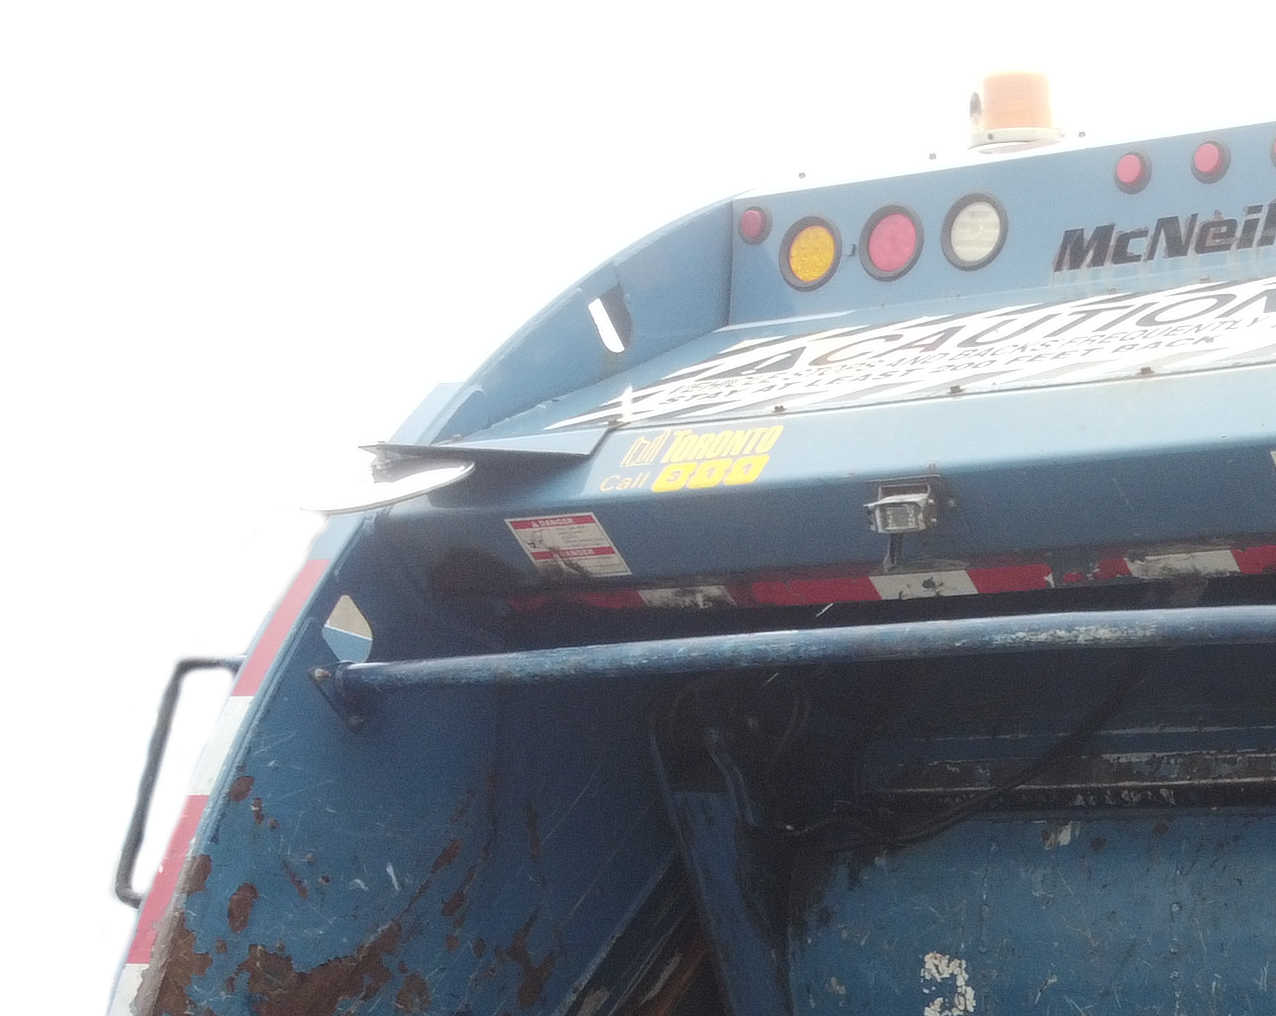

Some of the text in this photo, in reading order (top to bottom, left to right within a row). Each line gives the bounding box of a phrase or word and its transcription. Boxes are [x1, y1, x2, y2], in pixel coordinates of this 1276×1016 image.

[885, 351, 950, 368] AND
[947, 338, 1054, 362] BACKS
[1055, 315, 1273, 349] FREQUENTLY
[659, 334, 1225, 405] STAY AT LEAST 200 FEET BACK
[660, 425, 785, 464] TORONTO
[600, 458, 763, 493] Call 311
